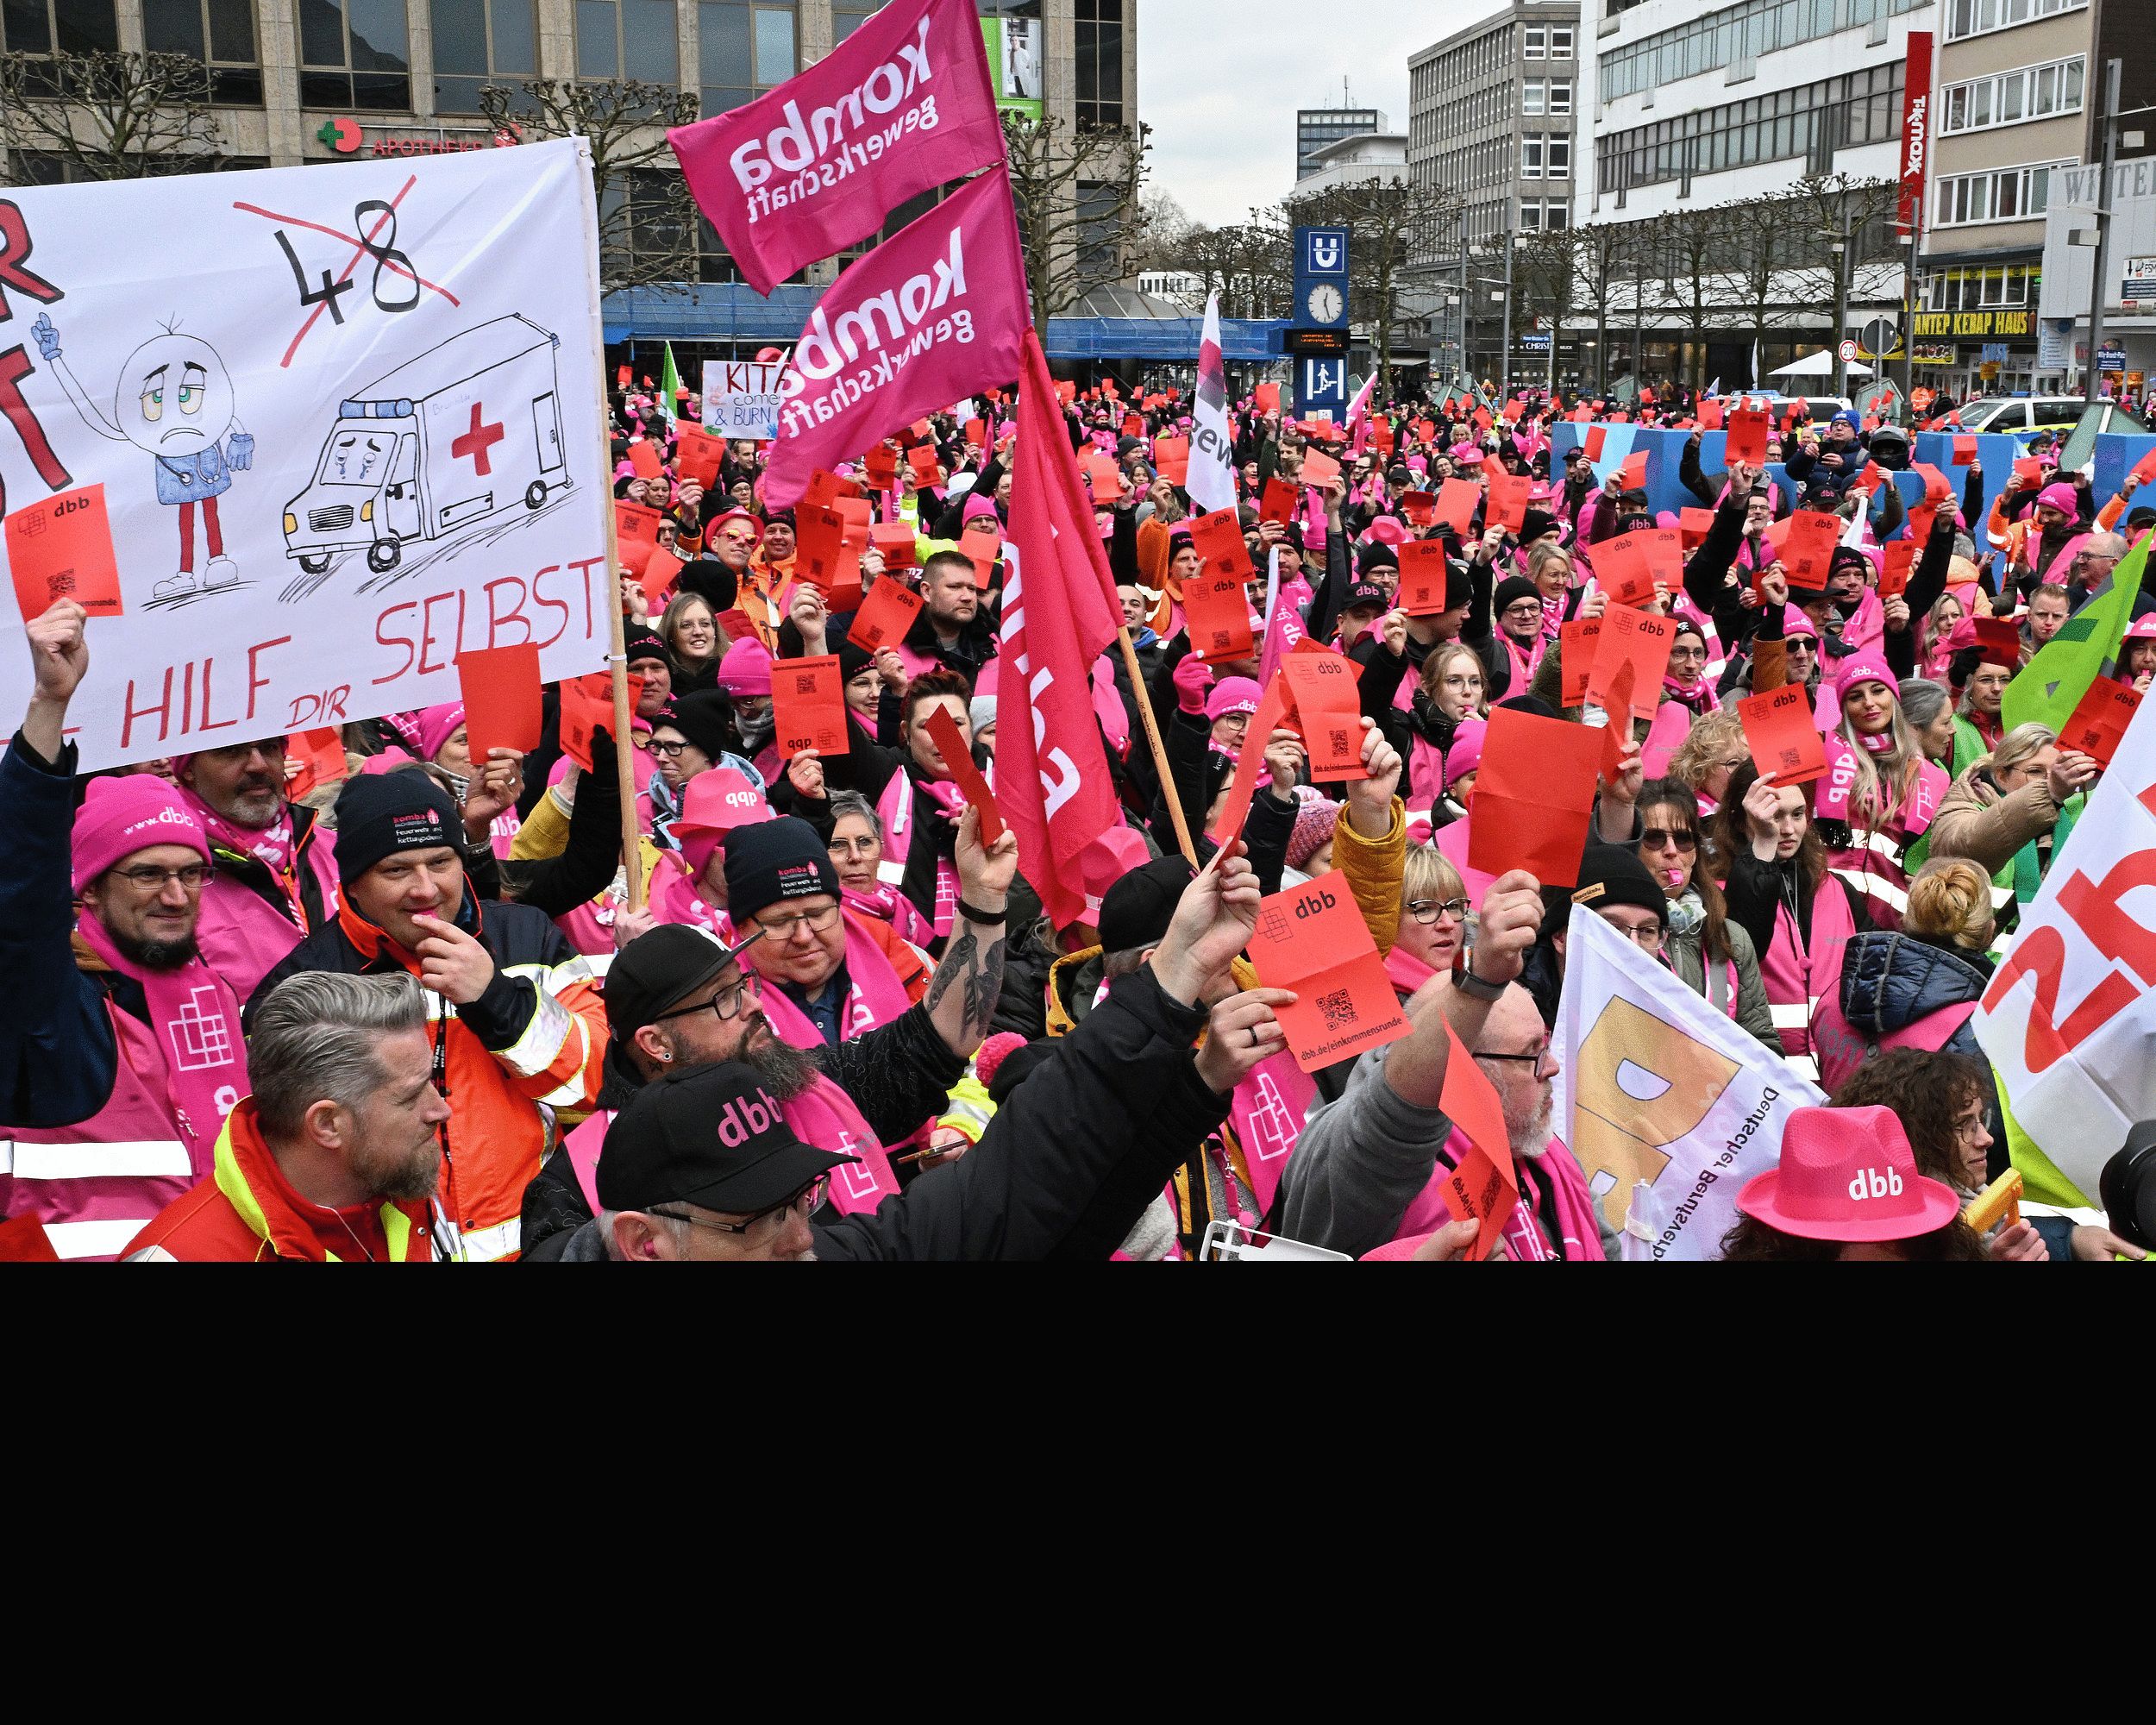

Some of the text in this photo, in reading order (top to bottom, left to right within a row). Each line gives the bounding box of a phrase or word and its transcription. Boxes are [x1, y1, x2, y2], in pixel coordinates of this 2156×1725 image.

[373, 138, 483, 156] APOTHEKE
[273, 199, 420, 325] 48
[1952, 311, 1992, 335] KEBAP
[1994, 310, 2028, 334] HAUS
[1843, 346, 1853, 356] 20
[734, 407, 771, 426] BURN
[54, 497, 90, 518] dbb
[1214, 514, 1231, 526] dbb
[1628, 519, 1651, 530] dbb
[1814, 519, 1833, 529] dbb
[1658, 532, 1676, 541] dbb
[1420, 545, 1438, 555] dbb
[1614, 540, 1633, 551] dbb
[1214, 580, 1236, 592] dbb
[1356, 586, 1380, 597] dbb
[896, 593, 915, 608] dbb
[1583, 624, 1600, 635] dbb
[1639, 620, 1664, 637] dbb
[121, 556, 605, 749] HILF DIR SELBST
[1318, 662, 1342, 674] dbb
[1773, 693, 1797, 707] dbb
[2115, 692, 2135, 707] dbb
[788, 737, 812, 750] dbb
[1828, 753, 1858, 803] dbb
[725, 792, 757, 808] dbb
[393, 813, 426, 824] komba
[778, 866, 807, 876] komba
[1295, 891, 1336, 919] dbb
[1300, 1017, 1403, 1062] dbb.de/einkommensrunde
[1849, 1167, 1904, 1201] dbb
